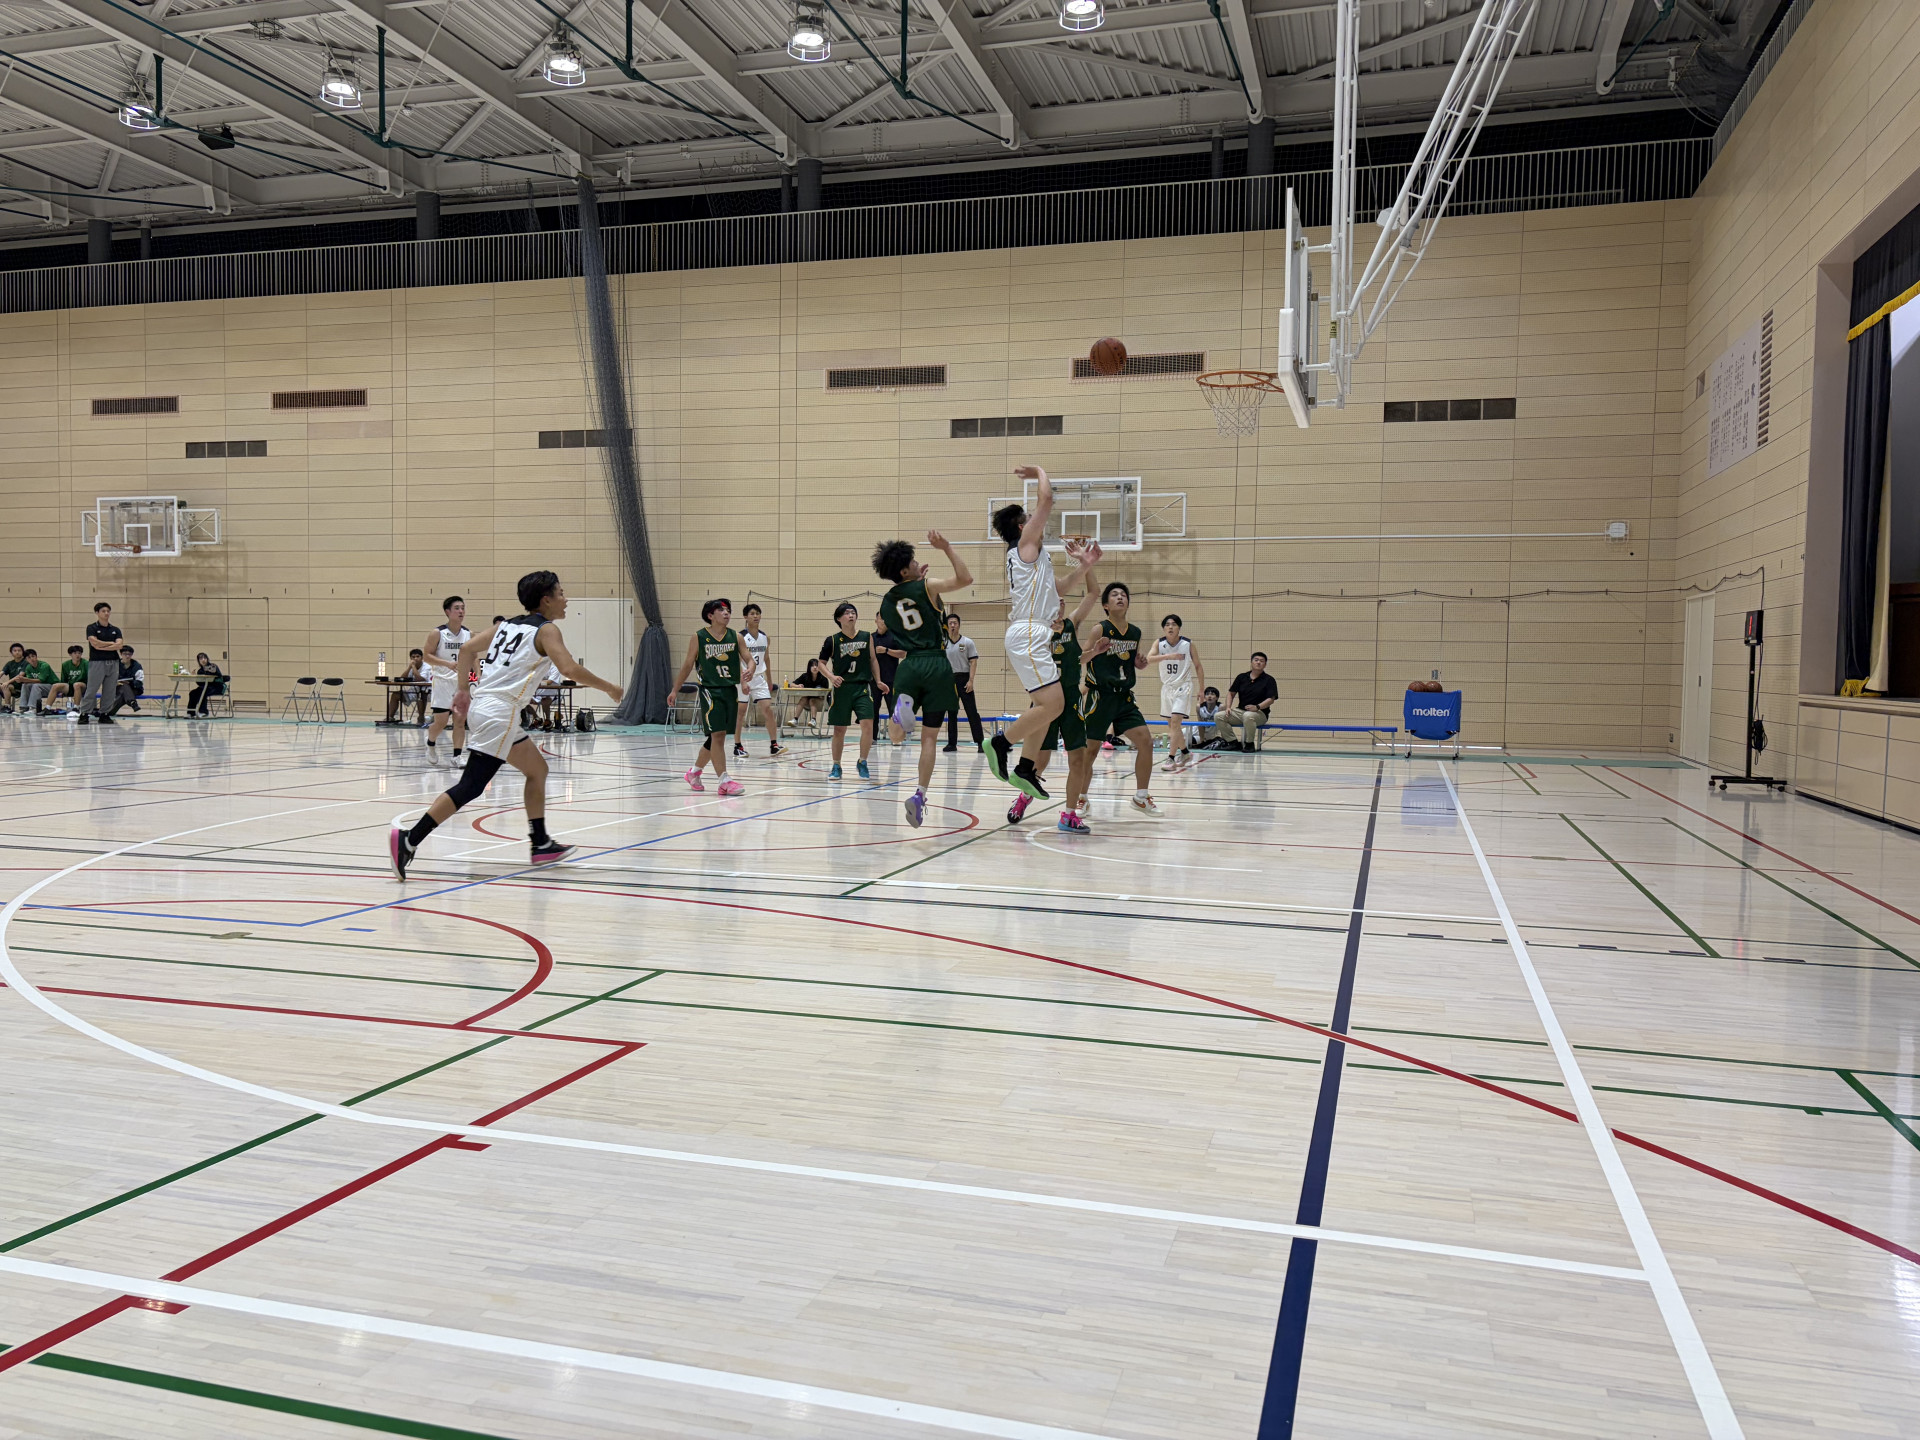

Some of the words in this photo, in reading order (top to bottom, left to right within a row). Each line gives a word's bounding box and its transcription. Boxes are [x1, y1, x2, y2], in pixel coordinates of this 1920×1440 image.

[895, 598, 924, 631] 6
[486, 629, 524, 666] 34
[1119, 665, 1127, 680] 1
[1166, 663, 1179, 675] 99
[1412, 707, 1450, 717] molten
